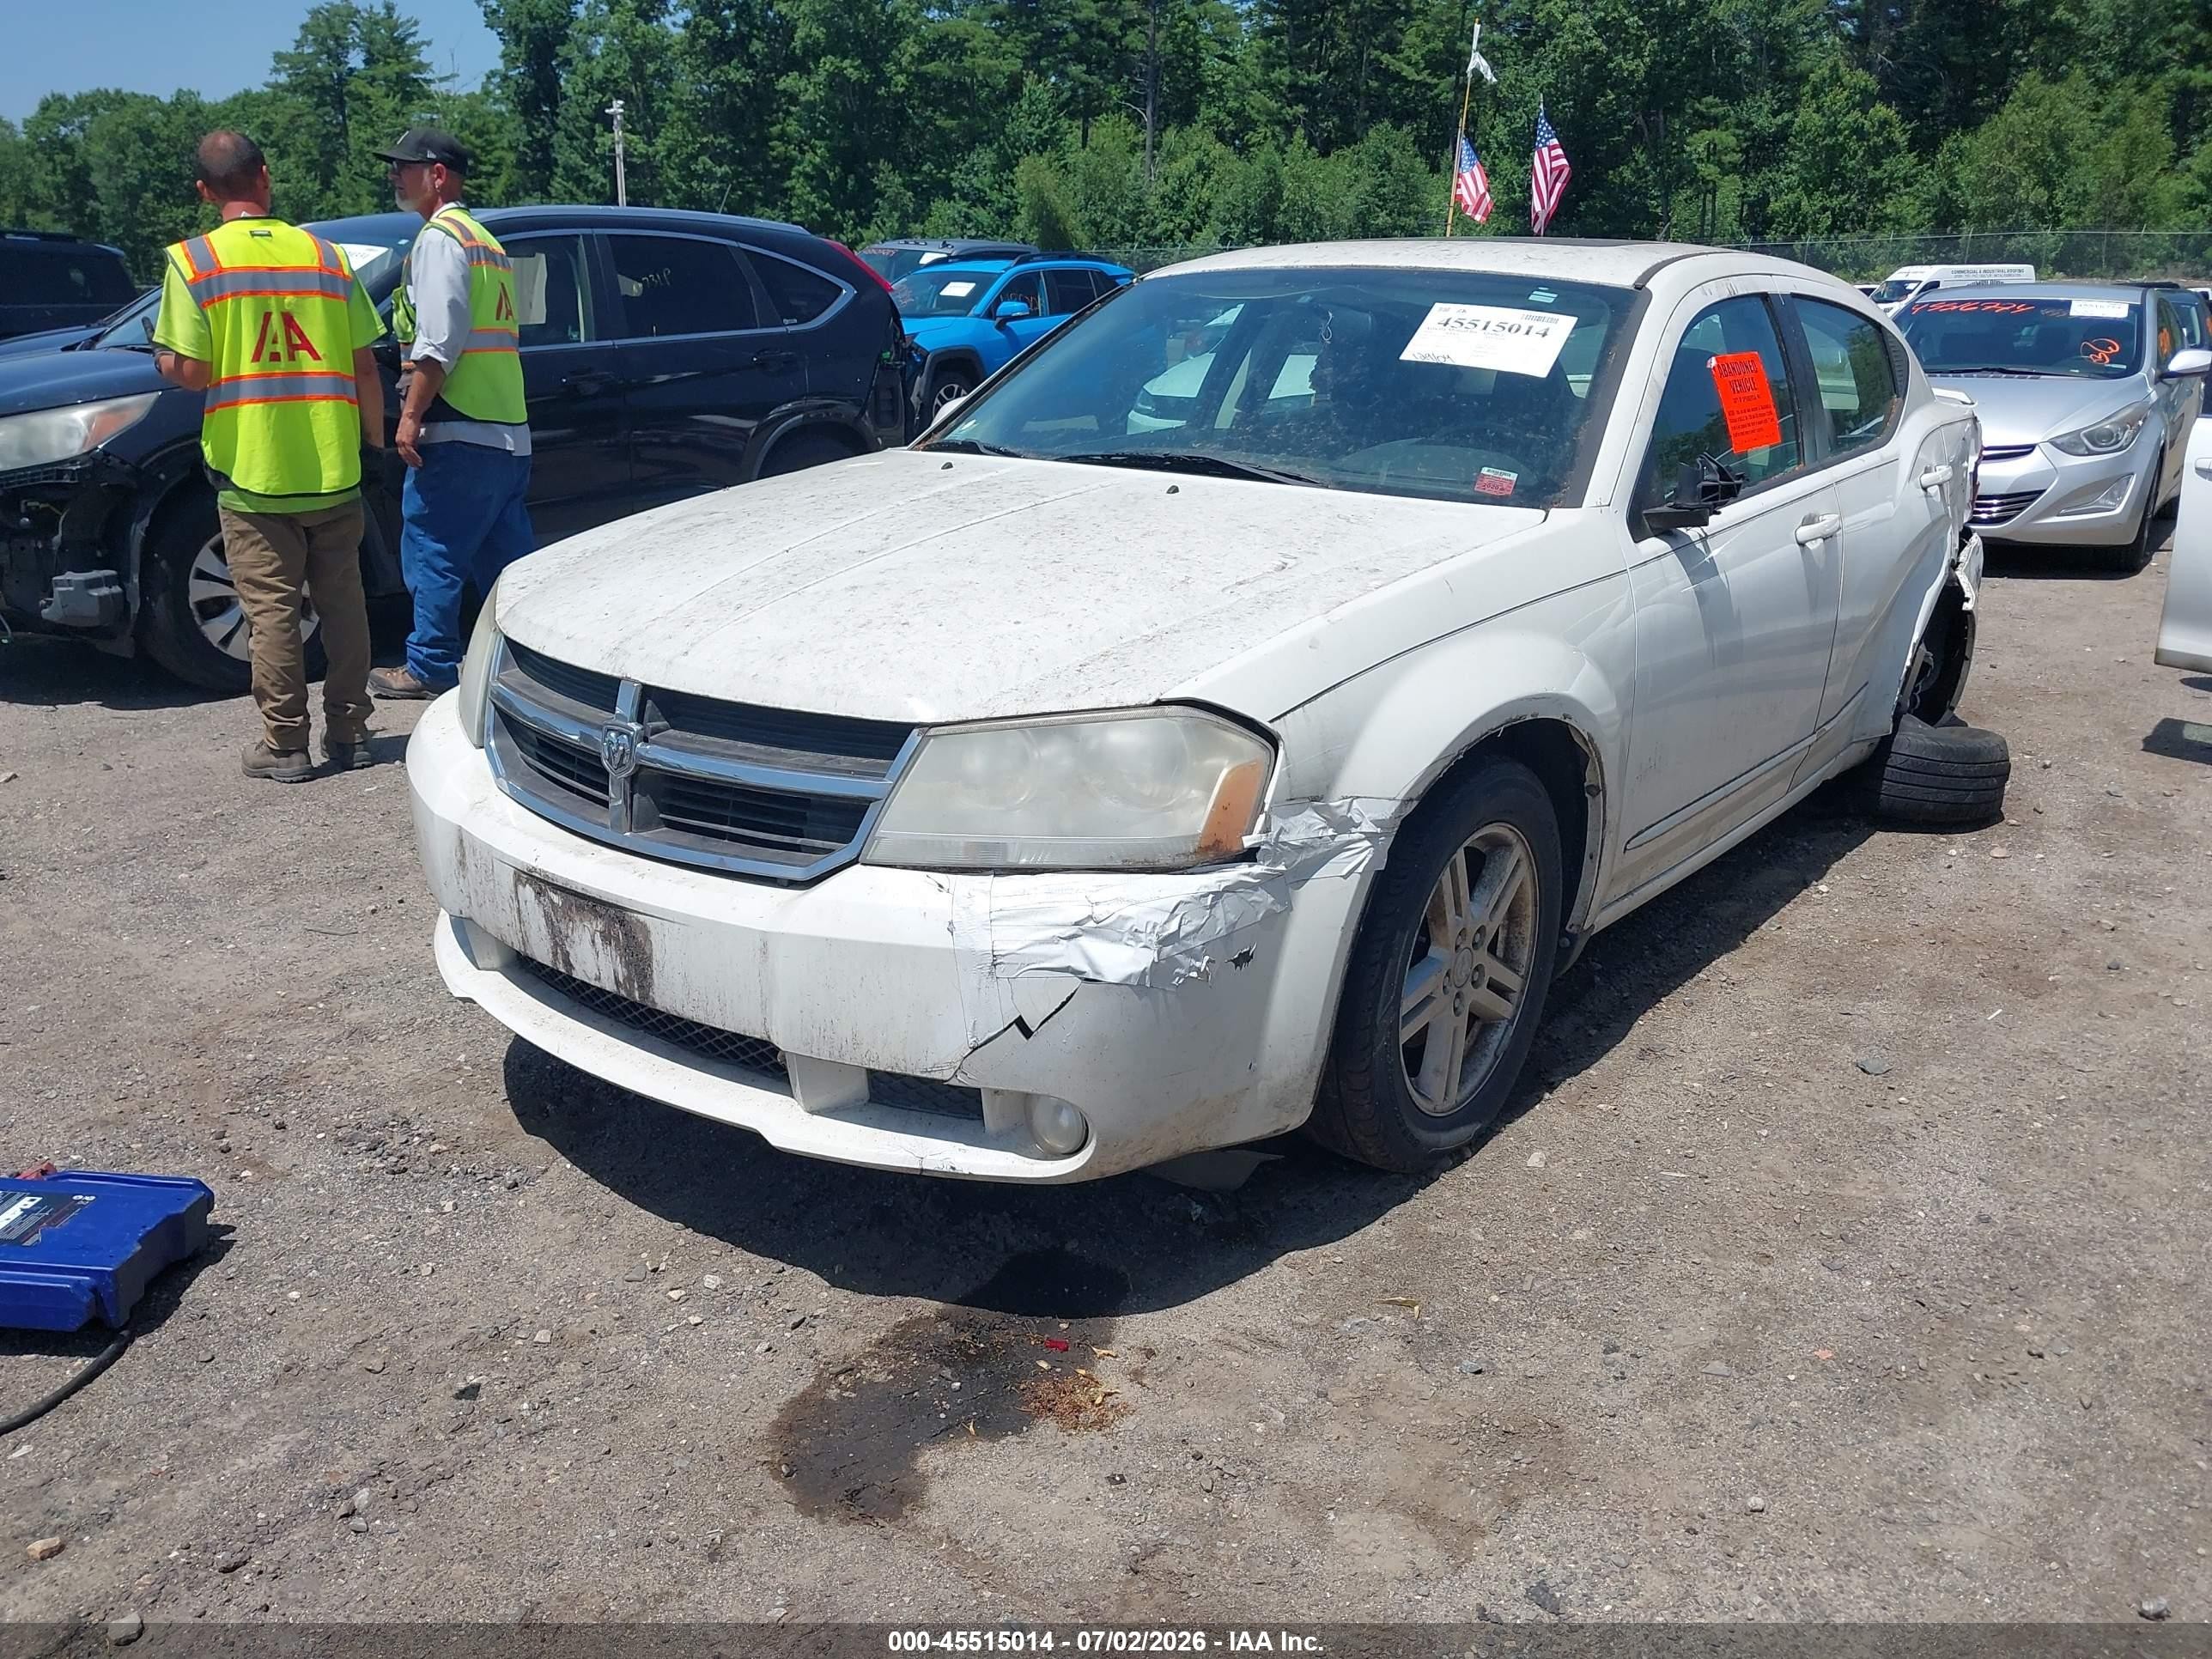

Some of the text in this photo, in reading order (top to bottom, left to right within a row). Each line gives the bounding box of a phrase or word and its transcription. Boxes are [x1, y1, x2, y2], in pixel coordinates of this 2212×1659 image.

[1437, 316, 1552, 338] 45515014
[1717, 359, 1759, 379] ABANDONED
[1729, 377, 1758, 394] VEHICLE
